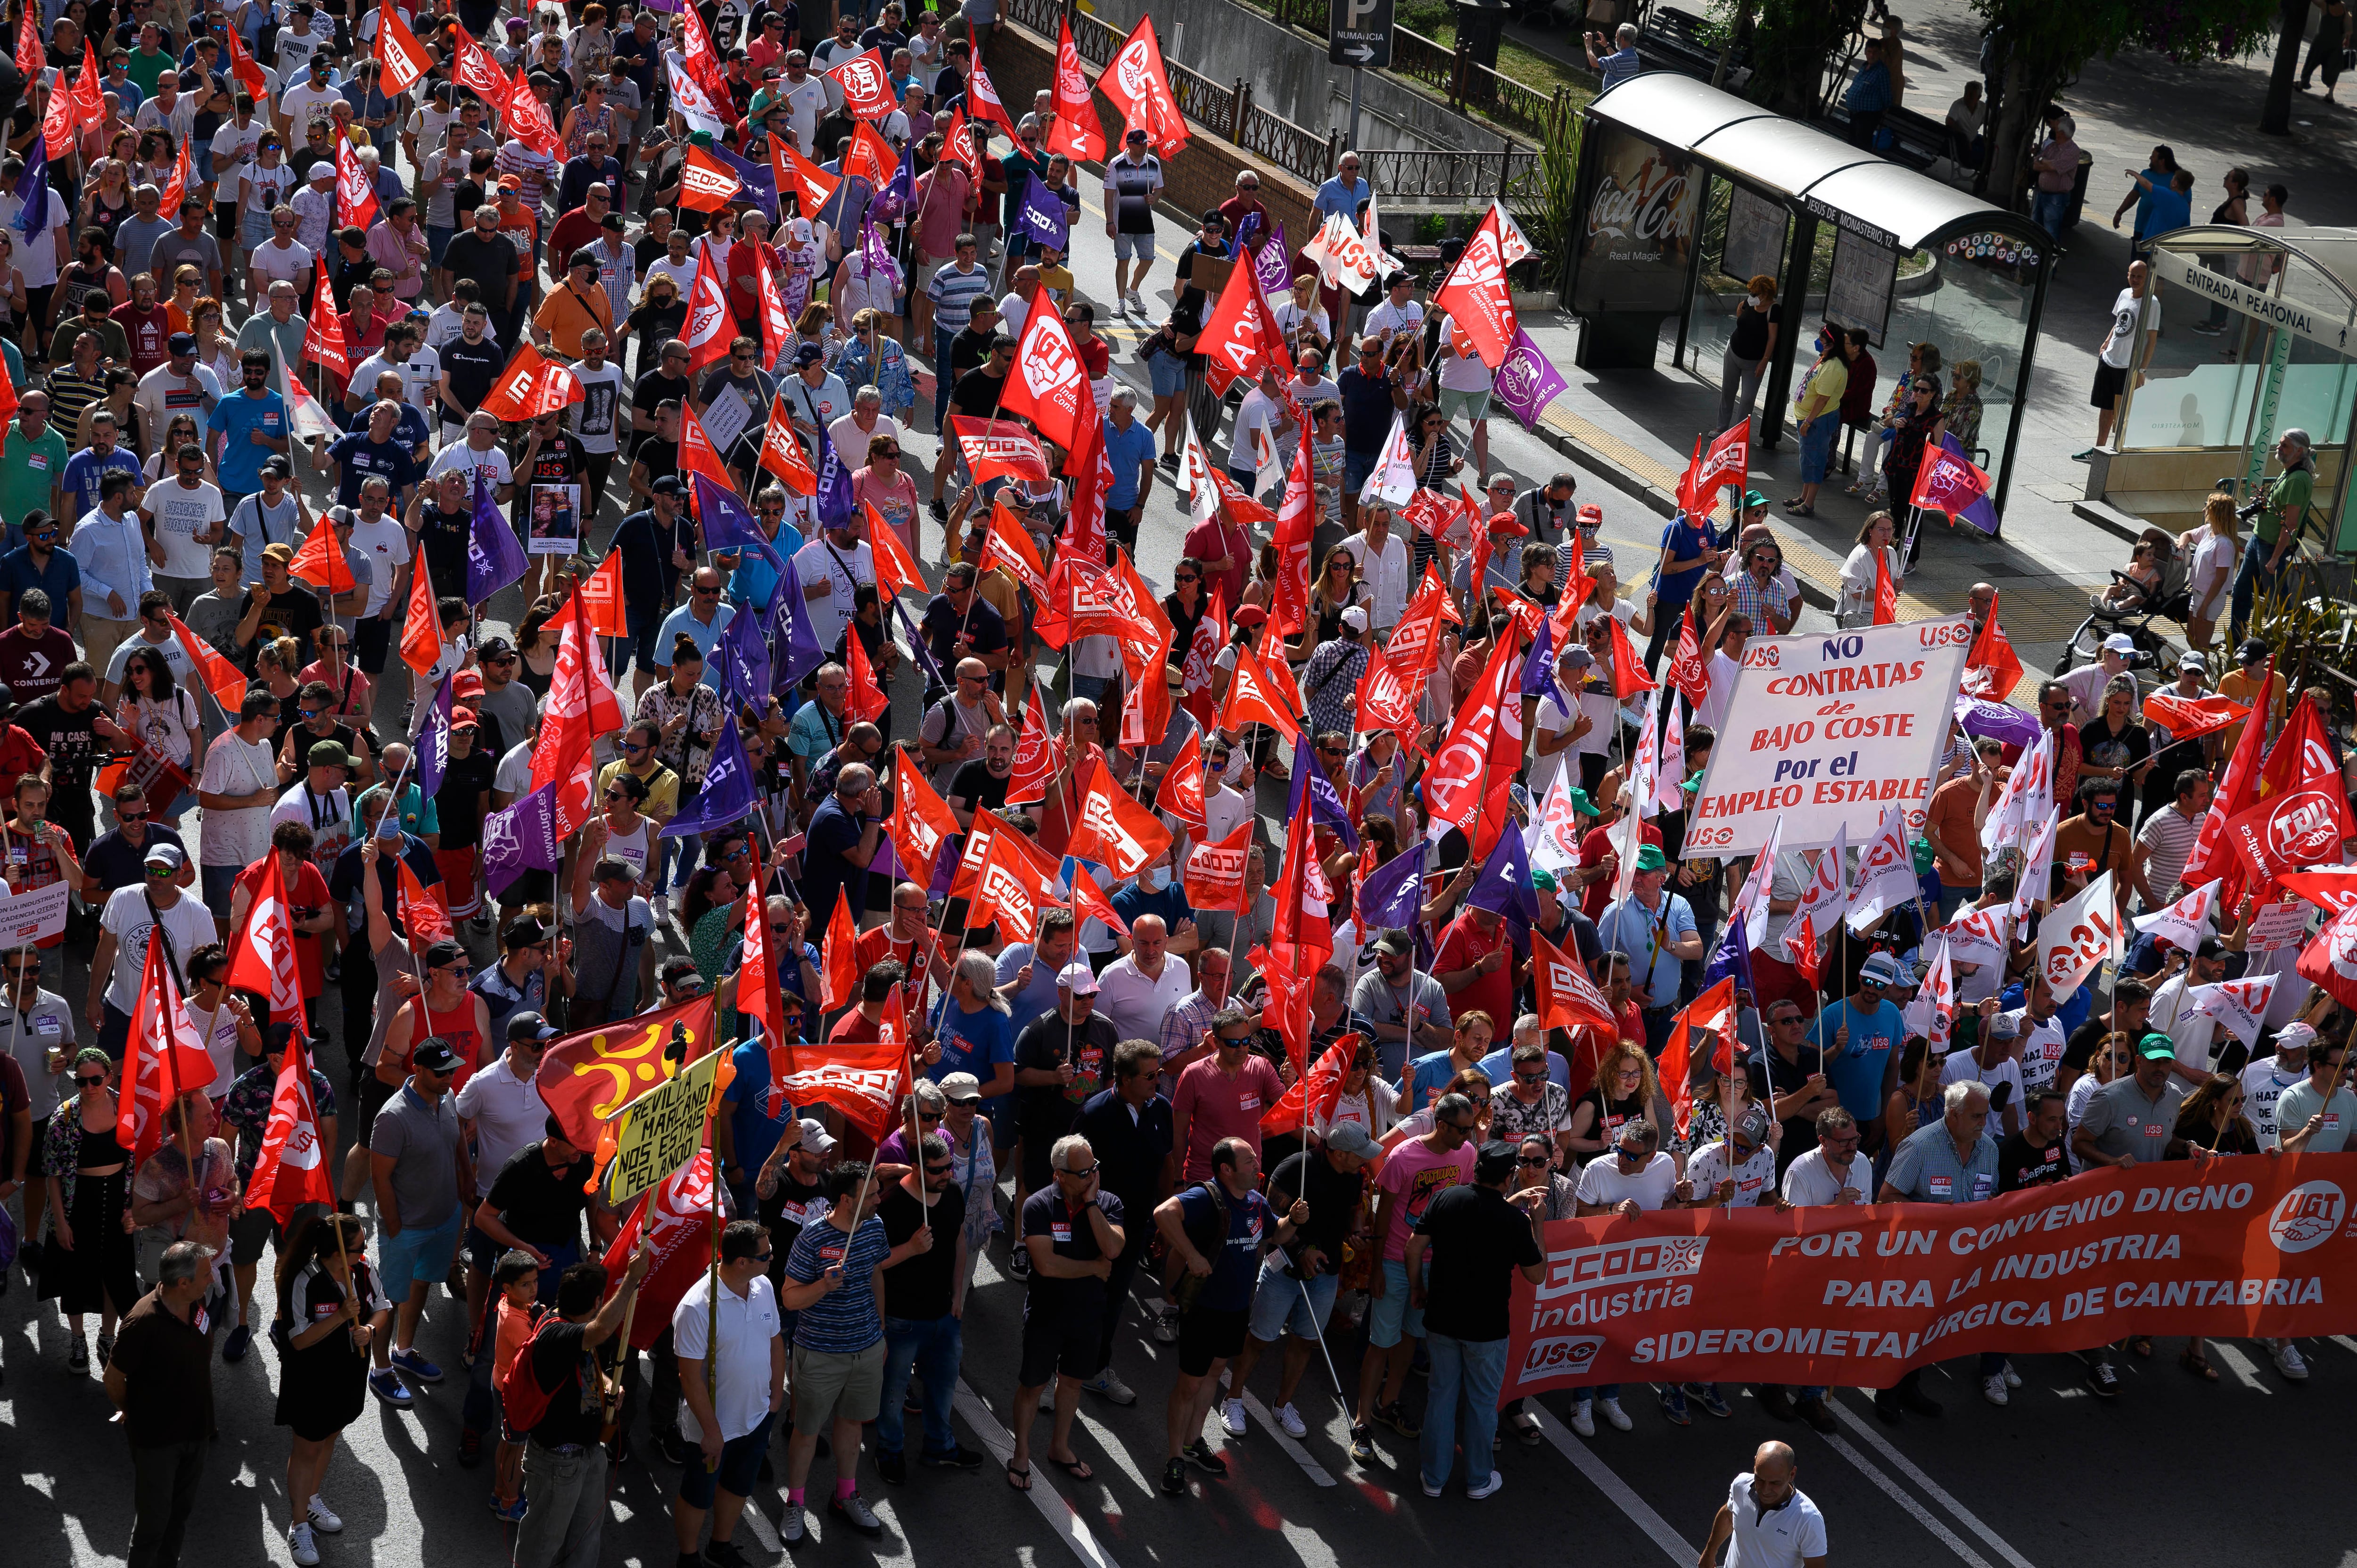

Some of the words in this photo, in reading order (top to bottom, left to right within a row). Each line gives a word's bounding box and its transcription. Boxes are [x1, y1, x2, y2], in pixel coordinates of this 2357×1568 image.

[718, 3, 737, 49] GAP
[282, 39, 309, 55] PUMA
[1807, 198, 1826, 215] JESÚS
[1827, 208, 1836, 221] DE
[1839, 213, 1884, 245] MONASTERIO,
[1886, 235, 1893, 247] 12
[1609, 252, 1631, 261] Real
[1633, 252, 1661, 262] Magic
[2185, 267, 2239, 305] ENTRADA
[2246, 293, 2312, 334] PEATONAL
[144, 341, 156, 350] 1949
[453, 353, 489, 362] Champion
[709, 411, 717, 423] ANTE
[716, 395, 730, 411] VUESTRA
[1524, 382, 1553, 422] www.ugt.es
[2251, 337, 2289, 477] MONASTERIO
[723, 413, 733, 428] METAL
[1920, 624, 1971, 646] USO
[1741, 645, 1780, 667] USO
[1822, 636, 1863, 661] NO
[14, 678, 60, 686] CONVERSE
[1767, 660, 1925, 697] CONTRATAS
[1816, 700, 1854, 716] de
[1749, 721, 1814, 752] BAJO
[1824, 714, 1915, 740] COSTE
[1773, 758, 1821, 782] Por
[1829, 751, 1858, 776] el
[1698, 784, 1803, 819] EMPLEO
[1812, 778, 1930, 804] ESTABLE
[536, 792, 555, 863] www.ugt.es
[556, 805, 572, 832] Agro
[1686, 827, 1734, 847] USO
[20, 894, 55, 909] INDUSTRIA
[57, 890, 66, 899] EN
[37, 904, 58, 914] OTERO
[9, 913, 57, 931] BENEFICIENCIA
[17, 927, 32, 936] UGT
[1552, 991, 1588, 1004] comisiones
[2180, 1010, 2191, 1020] UGT
[217, 1028, 230, 1038] UGT
[955, 1037, 967, 1047] CCOO
[1872, 1038, 1889, 1047] USO
[2022, 1049, 2041, 1064] HAZ
[2044, 1044, 2061, 1055] USO
[2022, 1068, 2037, 1079] DE
[2040, 1060, 2055, 1075] TUS
[630, 1074, 692, 1124] REVILLA
[2255, 1091, 2279, 1102] HAZ
[642, 1084, 711, 1141] MARCANO
[2258, 1108, 2272, 1118] DE
[2145, 1125, 2162, 1134] USO
[618, 1149, 651, 1179] NOS
[659, 1106, 705, 1159] ESTAIS
[2046, 1147, 2059, 1159] USO
[626, 1141, 692, 1198] PELANDO
[1415, 1165, 1460, 1188] Paraiso
[786, 1201, 799, 1210] UGT
[2274, 1193, 2330, 1222] UGT
[1771, 1231, 1862, 1258] POR
[1876, 1229, 1937, 1256] UN
[1949, 1190, 2124, 1256] CONVENIO
[2133, 1183, 2253, 1213] DIGNO
[1545, 1246, 1662, 1289] CCOO
[1823, 1280, 1935, 1306] PARA
[1946, 1267, 1982, 1303] LA
[1990, 1234, 2181, 1282] INDUSTRIA
[1530, 1280, 1694, 1333] industria
[1631, 1301, 2051, 1363] SIDEROMETALÚRGICA
[2062, 1287, 2107, 1322] DE
[2114, 1276, 2323, 1308] CANTABRIA
[1525, 1342, 1599, 1370] USO
